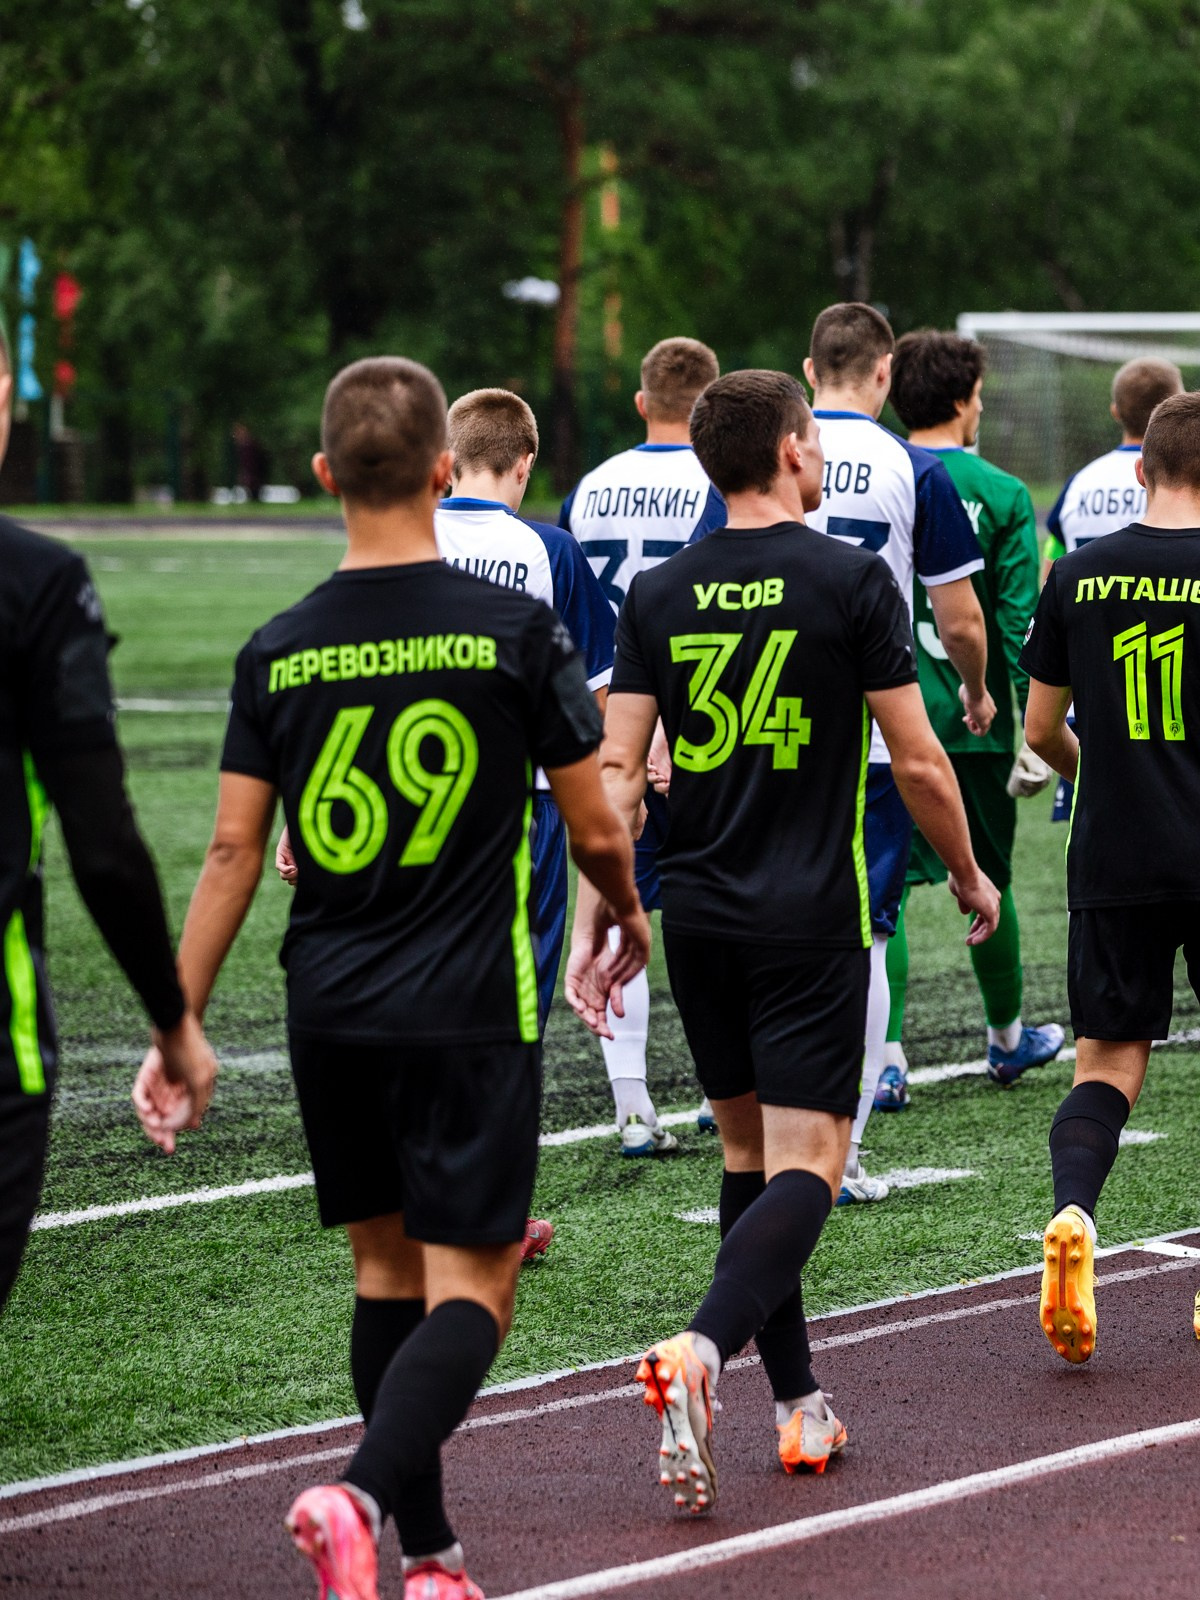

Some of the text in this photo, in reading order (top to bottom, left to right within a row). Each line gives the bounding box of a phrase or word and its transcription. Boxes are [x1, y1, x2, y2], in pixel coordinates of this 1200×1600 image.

[583, 487, 700, 520] ПОЛЯКИН
[692, 577, 785, 611] УСОВ
[268, 633, 497, 694] ПЕРЕВОЗНИКОВ
[669, 629, 812, 773] 34
[1113, 620, 1186, 741] 11
[298, 698, 480, 875] 69
